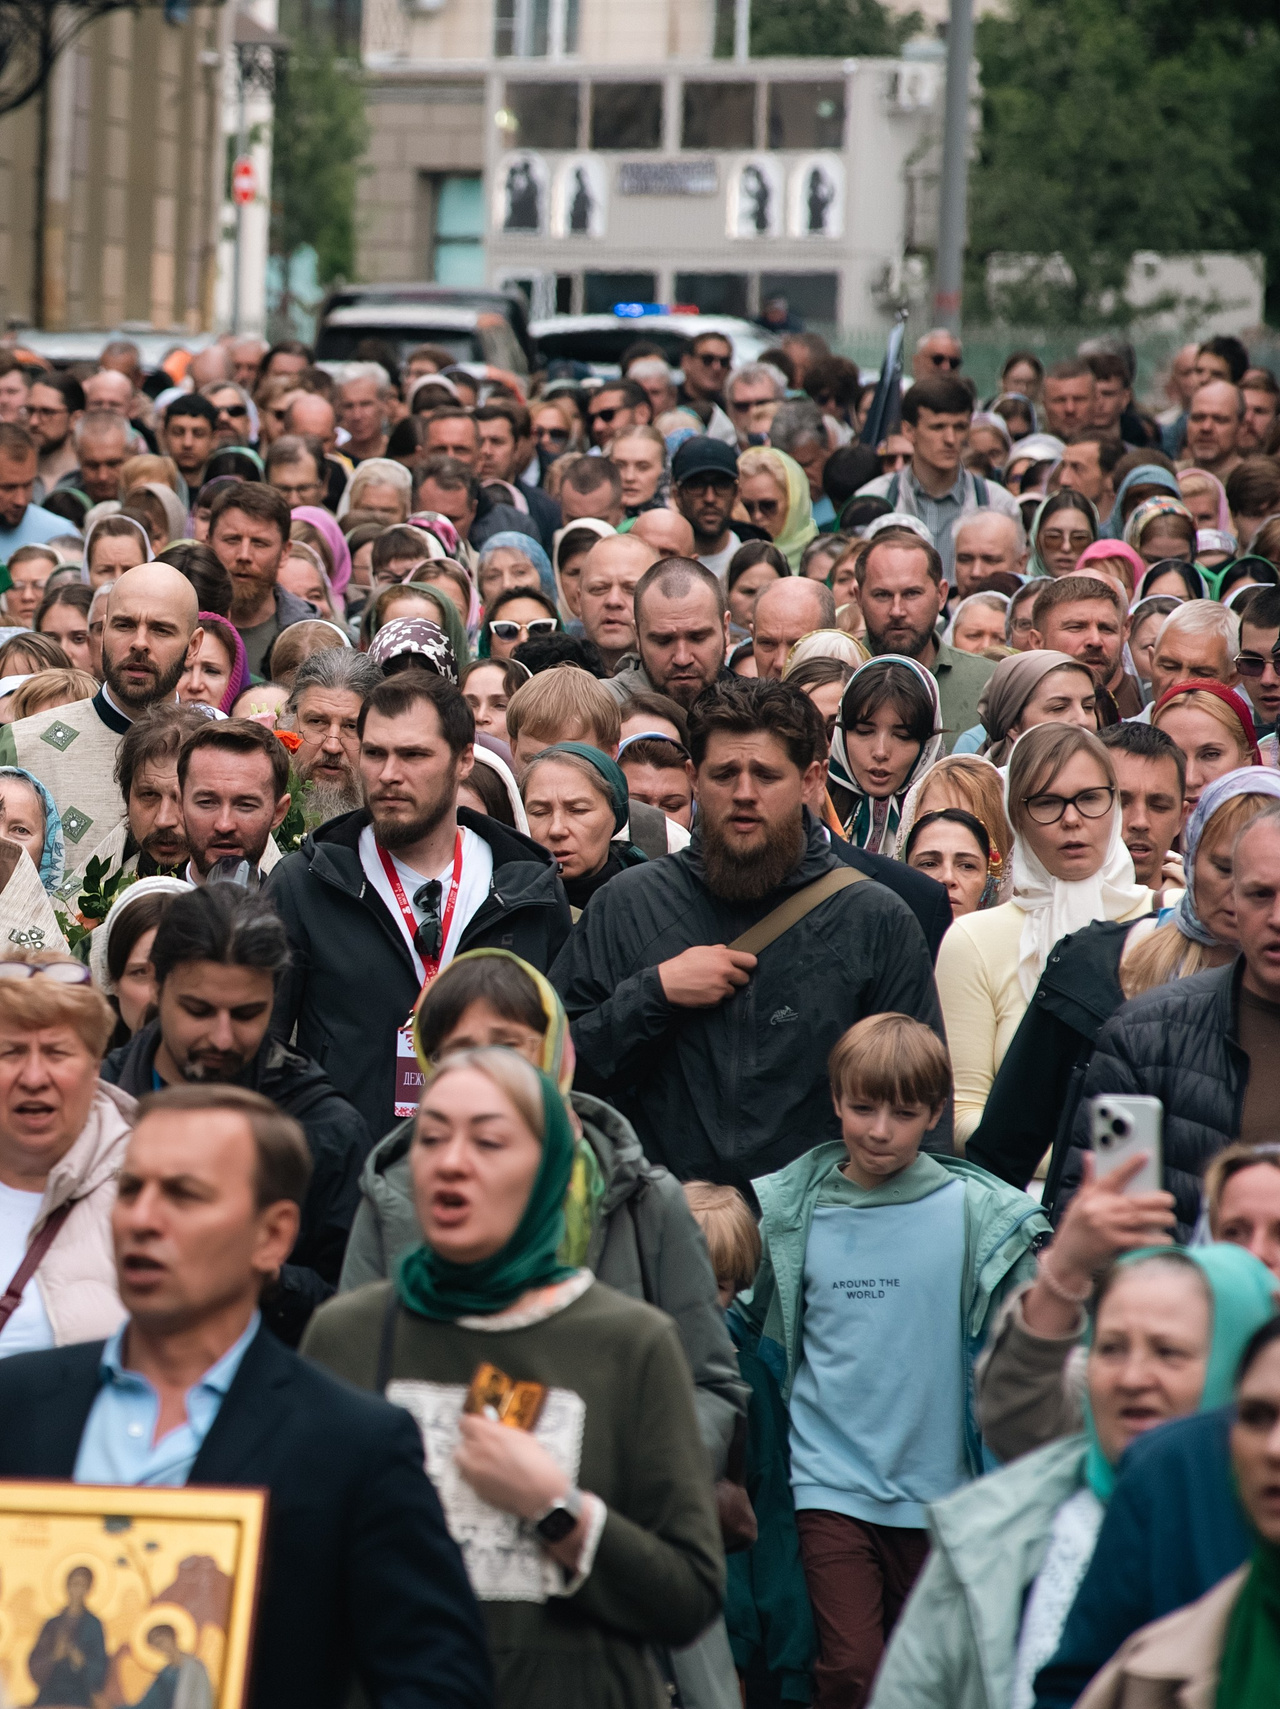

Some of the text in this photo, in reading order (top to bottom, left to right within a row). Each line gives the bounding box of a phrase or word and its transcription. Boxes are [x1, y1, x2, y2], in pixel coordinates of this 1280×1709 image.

[832, 1278, 901, 1290] AROUND THE
[846, 1290, 886, 1300] WORLD
